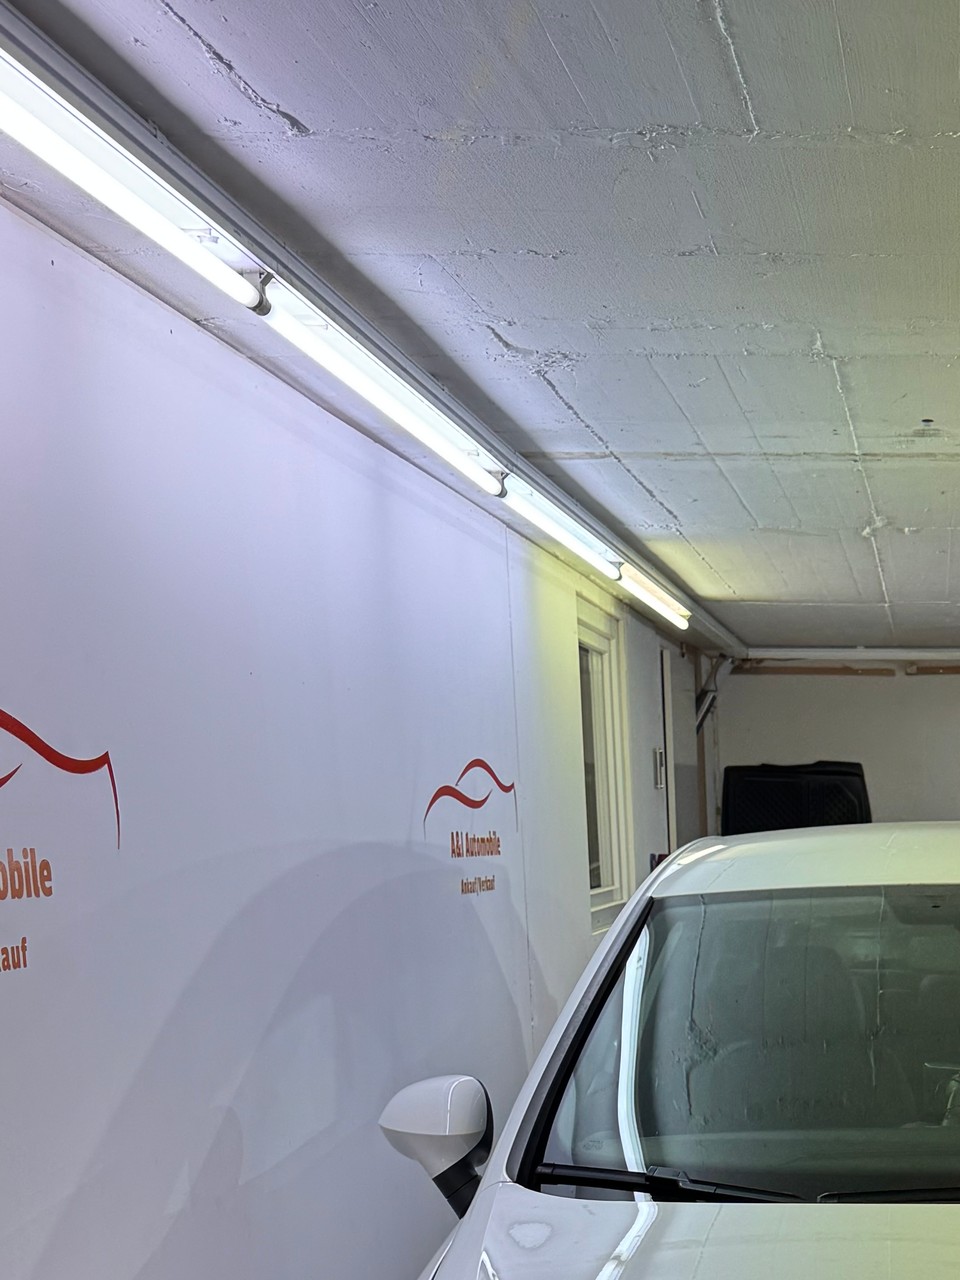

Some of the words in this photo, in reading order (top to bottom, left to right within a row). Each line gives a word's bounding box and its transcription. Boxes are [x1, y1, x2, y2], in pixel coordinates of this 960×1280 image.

[450, 831, 464, 858] A&I
[465, 830, 501, 858] Automobile
[0, 936, 28, 972] auf
